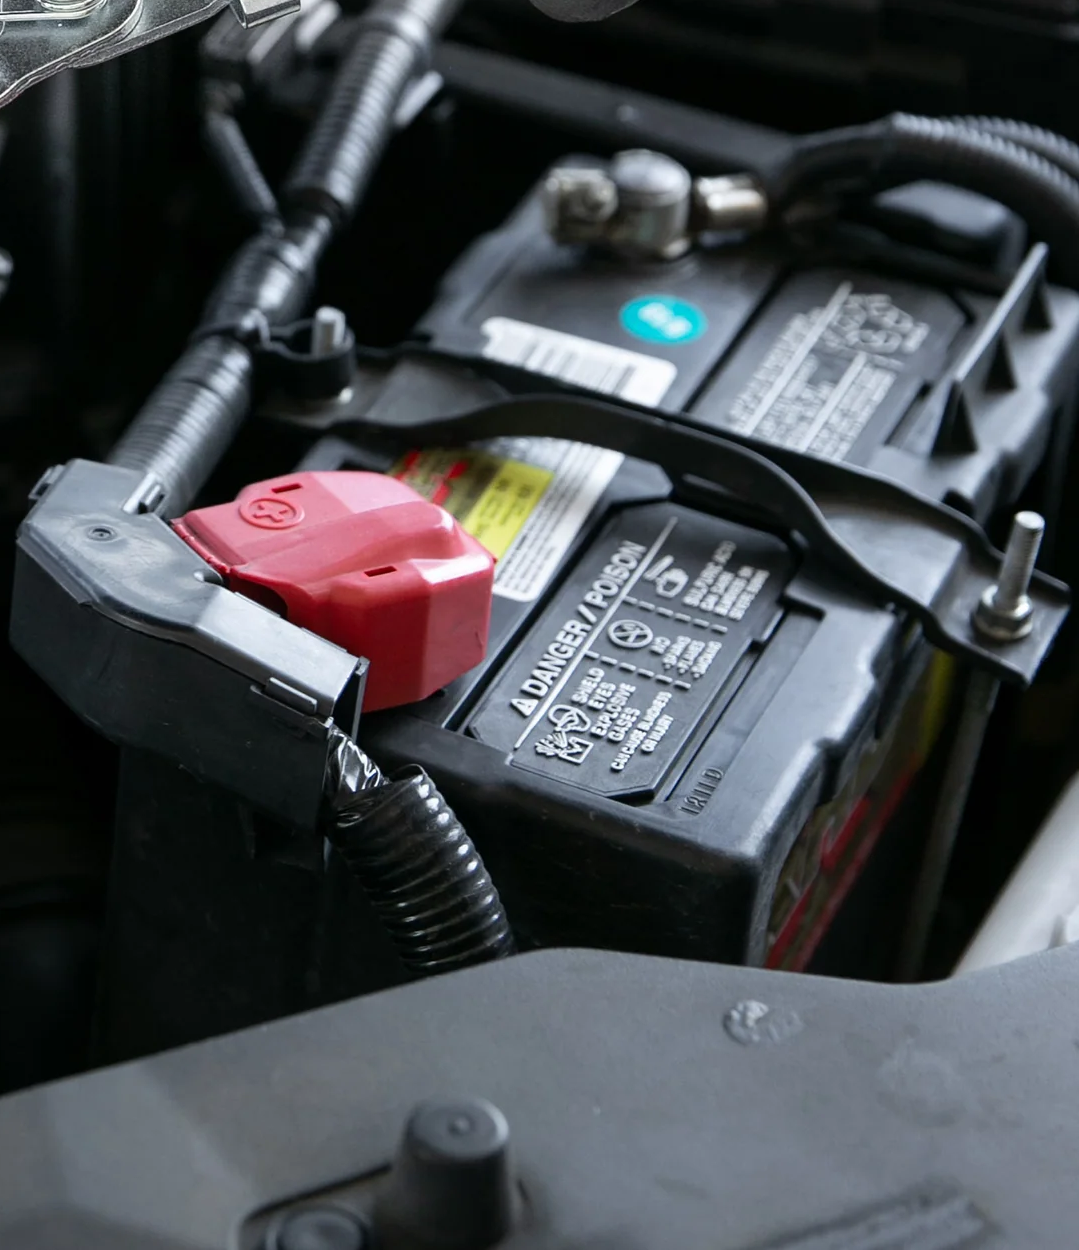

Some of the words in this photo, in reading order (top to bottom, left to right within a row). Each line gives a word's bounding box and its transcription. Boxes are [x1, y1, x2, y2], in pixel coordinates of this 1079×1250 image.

[521, 619, 592, 697] DANGER
[584, 540, 647, 609] POISON
[650, 636, 671, 655] NO
[571, 668, 605, 704] SHIELD
[587, 682, 616, 709] EYES
[590, 683, 636, 737] EXPLOSIVE
[607, 707, 641, 742] GASES
[611, 752, 631, 770] CAN
[622, 729, 647, 755] CAUSE
[637, 691, 672, 731] BLINDNESS
[641, 738, 658, 752] OR
